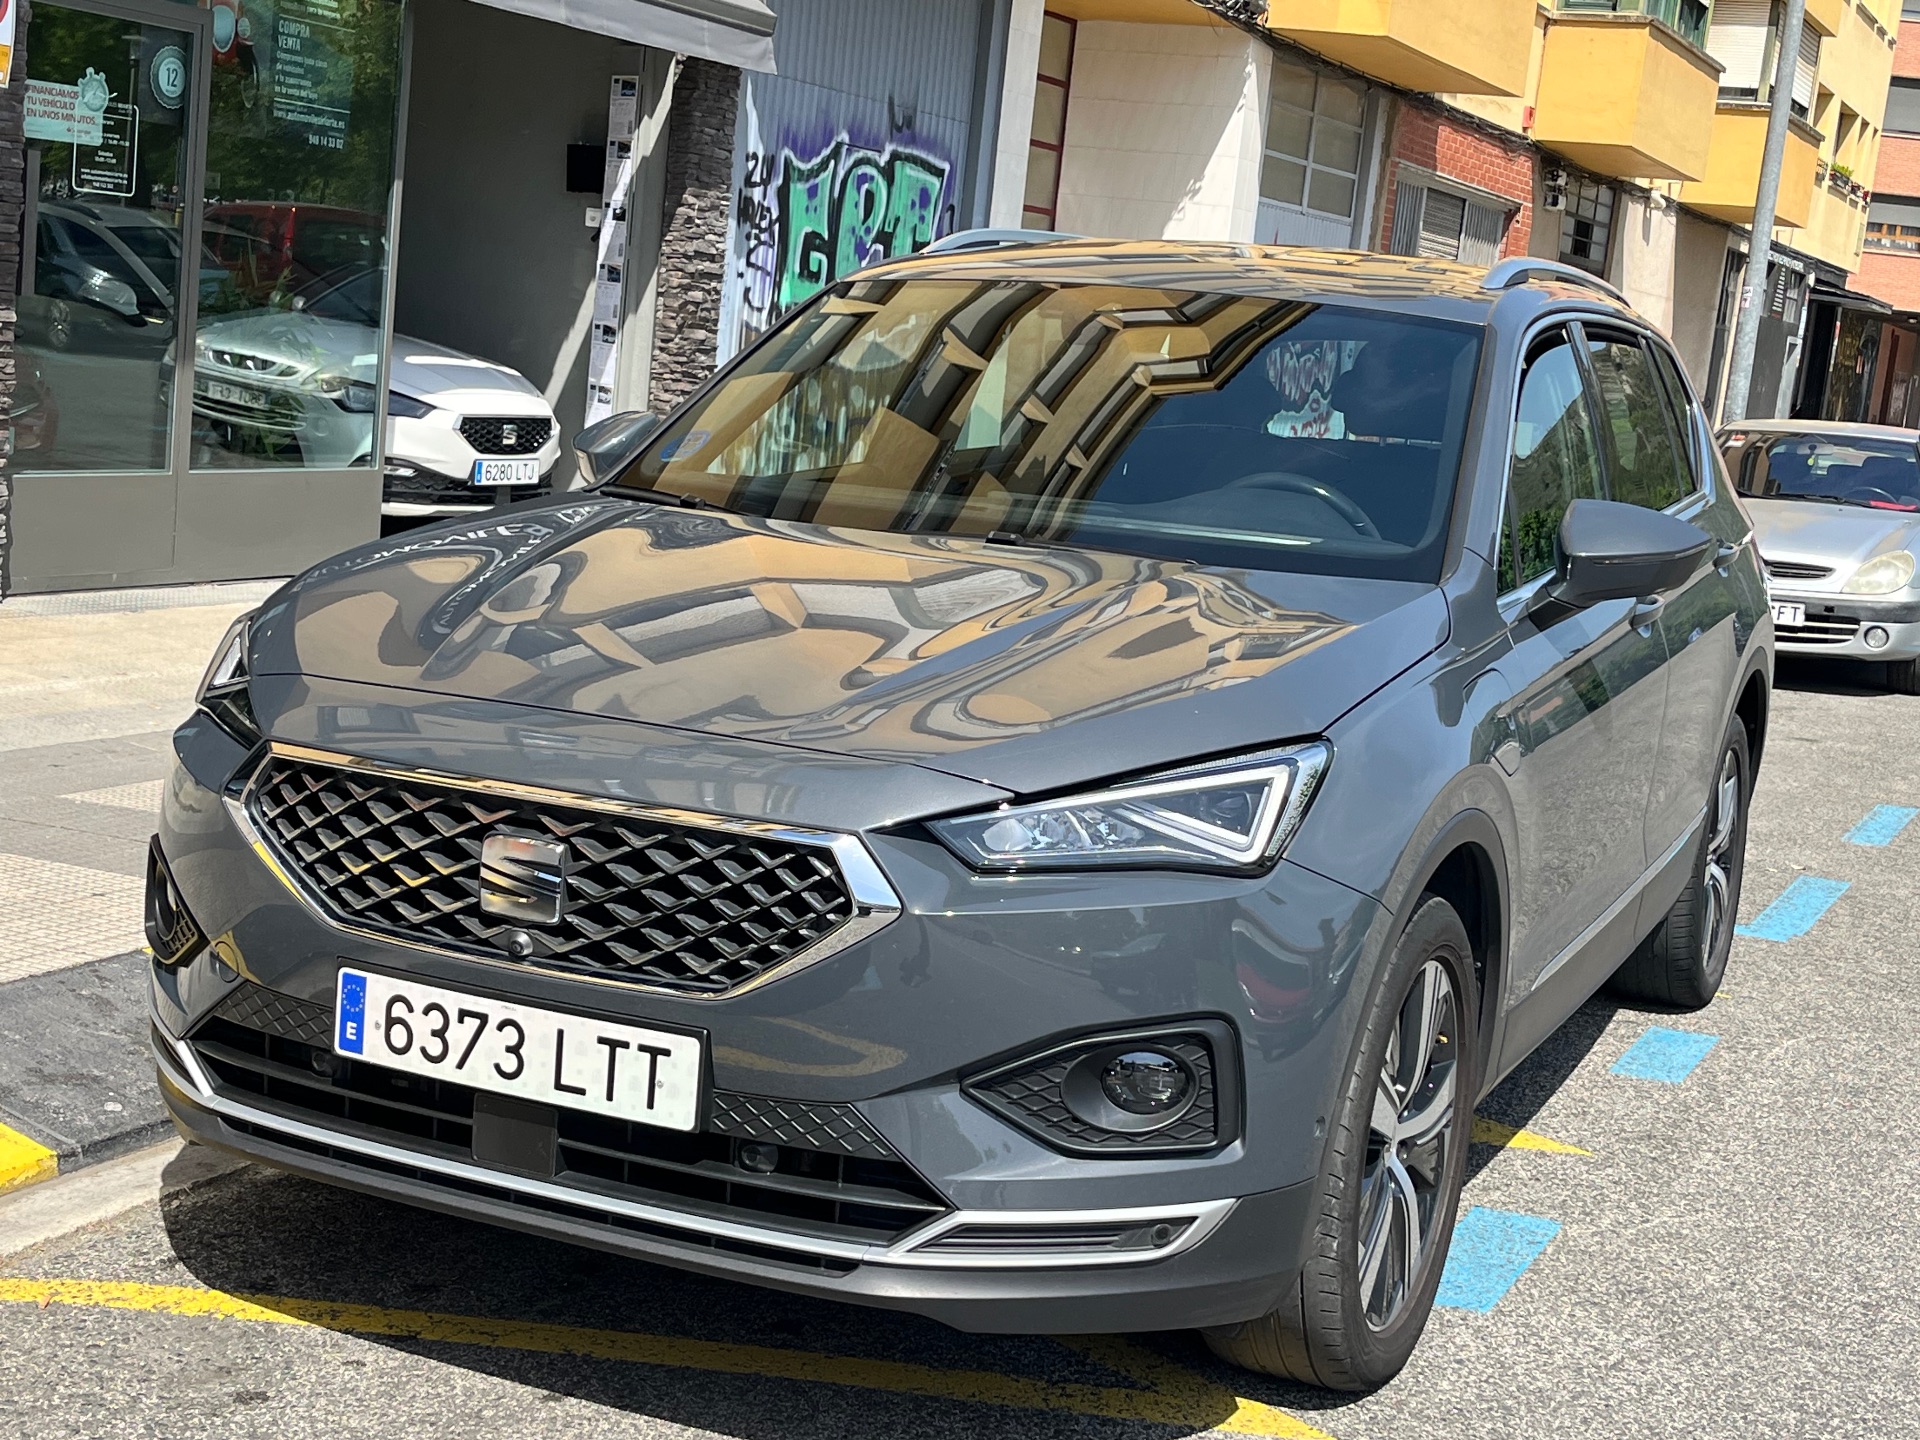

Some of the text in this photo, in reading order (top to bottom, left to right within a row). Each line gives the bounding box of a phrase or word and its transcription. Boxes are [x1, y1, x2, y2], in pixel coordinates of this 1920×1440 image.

[279, 20, 310, 38] COMPRA
[278, 34, 301, 51] VENTA
[166, 67, 178, 87] 12
[27, 96, 37, 106] TU
[27, 108, 37, 117] EN
[38, 109, 60, 120] UNOS
[485, 464, 535, 481] 6280 LTJ
[345, 1021, 358, 1041] E
[384, 994, 672, 1111] 6373 LTT
